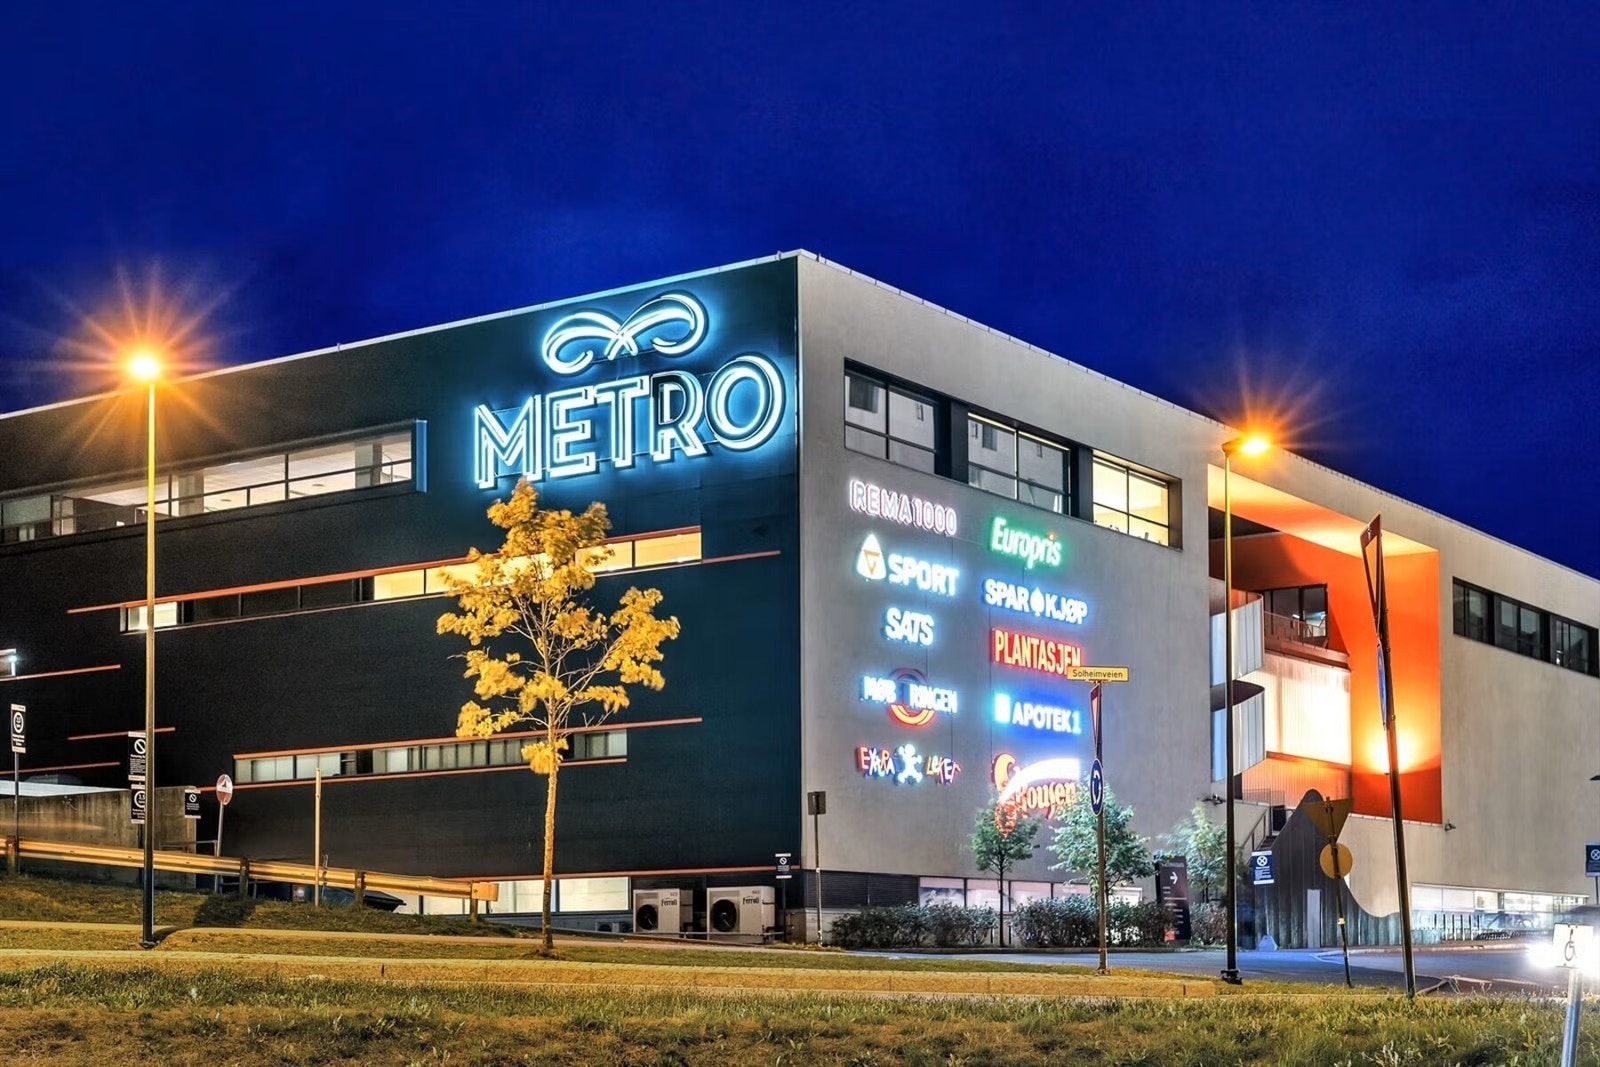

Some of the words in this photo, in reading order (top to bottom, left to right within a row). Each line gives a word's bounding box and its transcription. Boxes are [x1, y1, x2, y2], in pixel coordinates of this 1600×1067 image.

[474, 355, 786, 489] METRO
[850, 479, 914, 526] REMA
[913, 499, 958, 537] 1000
[991, 516, 1062, 569] Europris
[888, 552, 960, 597] SPORT
[984, 578, 1030, 613] SPAR
[1045, 592, 1088, 625] KJØP
[885, 607, 935, 647] SATS
[1072, 668, 1123, 679] Solheimveien
[1012, 702, 1073, 733] APOTEK
